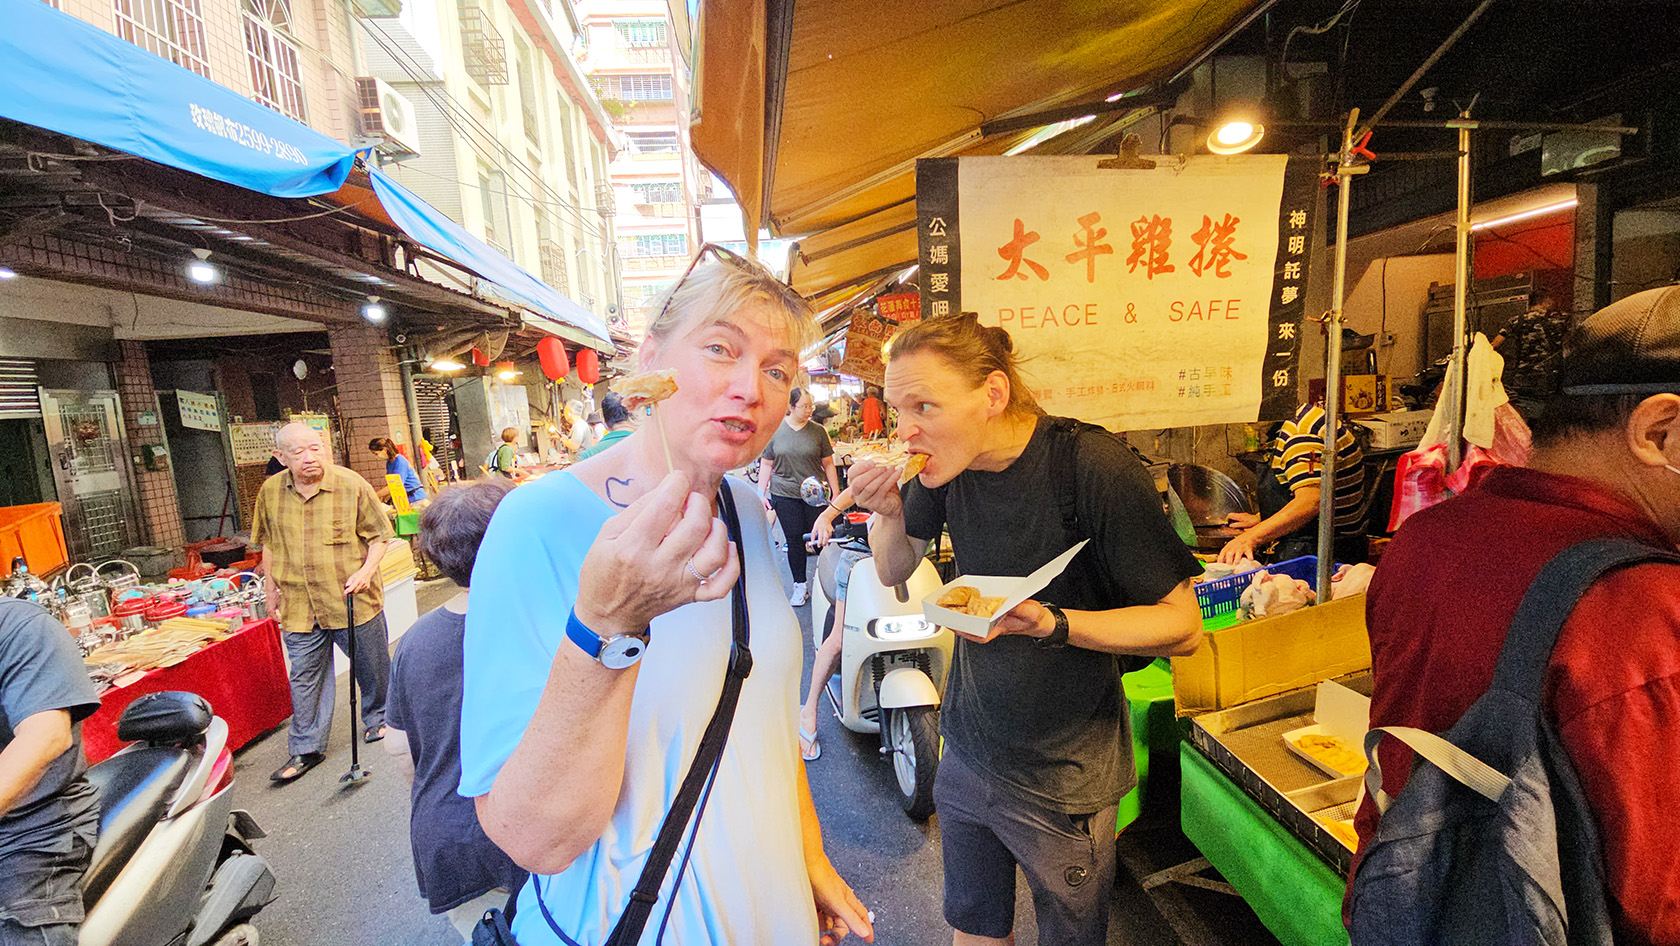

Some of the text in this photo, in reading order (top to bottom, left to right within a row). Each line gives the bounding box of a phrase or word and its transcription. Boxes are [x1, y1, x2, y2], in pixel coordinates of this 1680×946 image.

[929, 217, 949, 318] 公媽愛呷
[996, 211, 1248, 283] 太平雞捲
[999, 299, 1242, 330] PEACE & SAFE
[1272, 210, 1307, 387] 神明託夢 來一份
